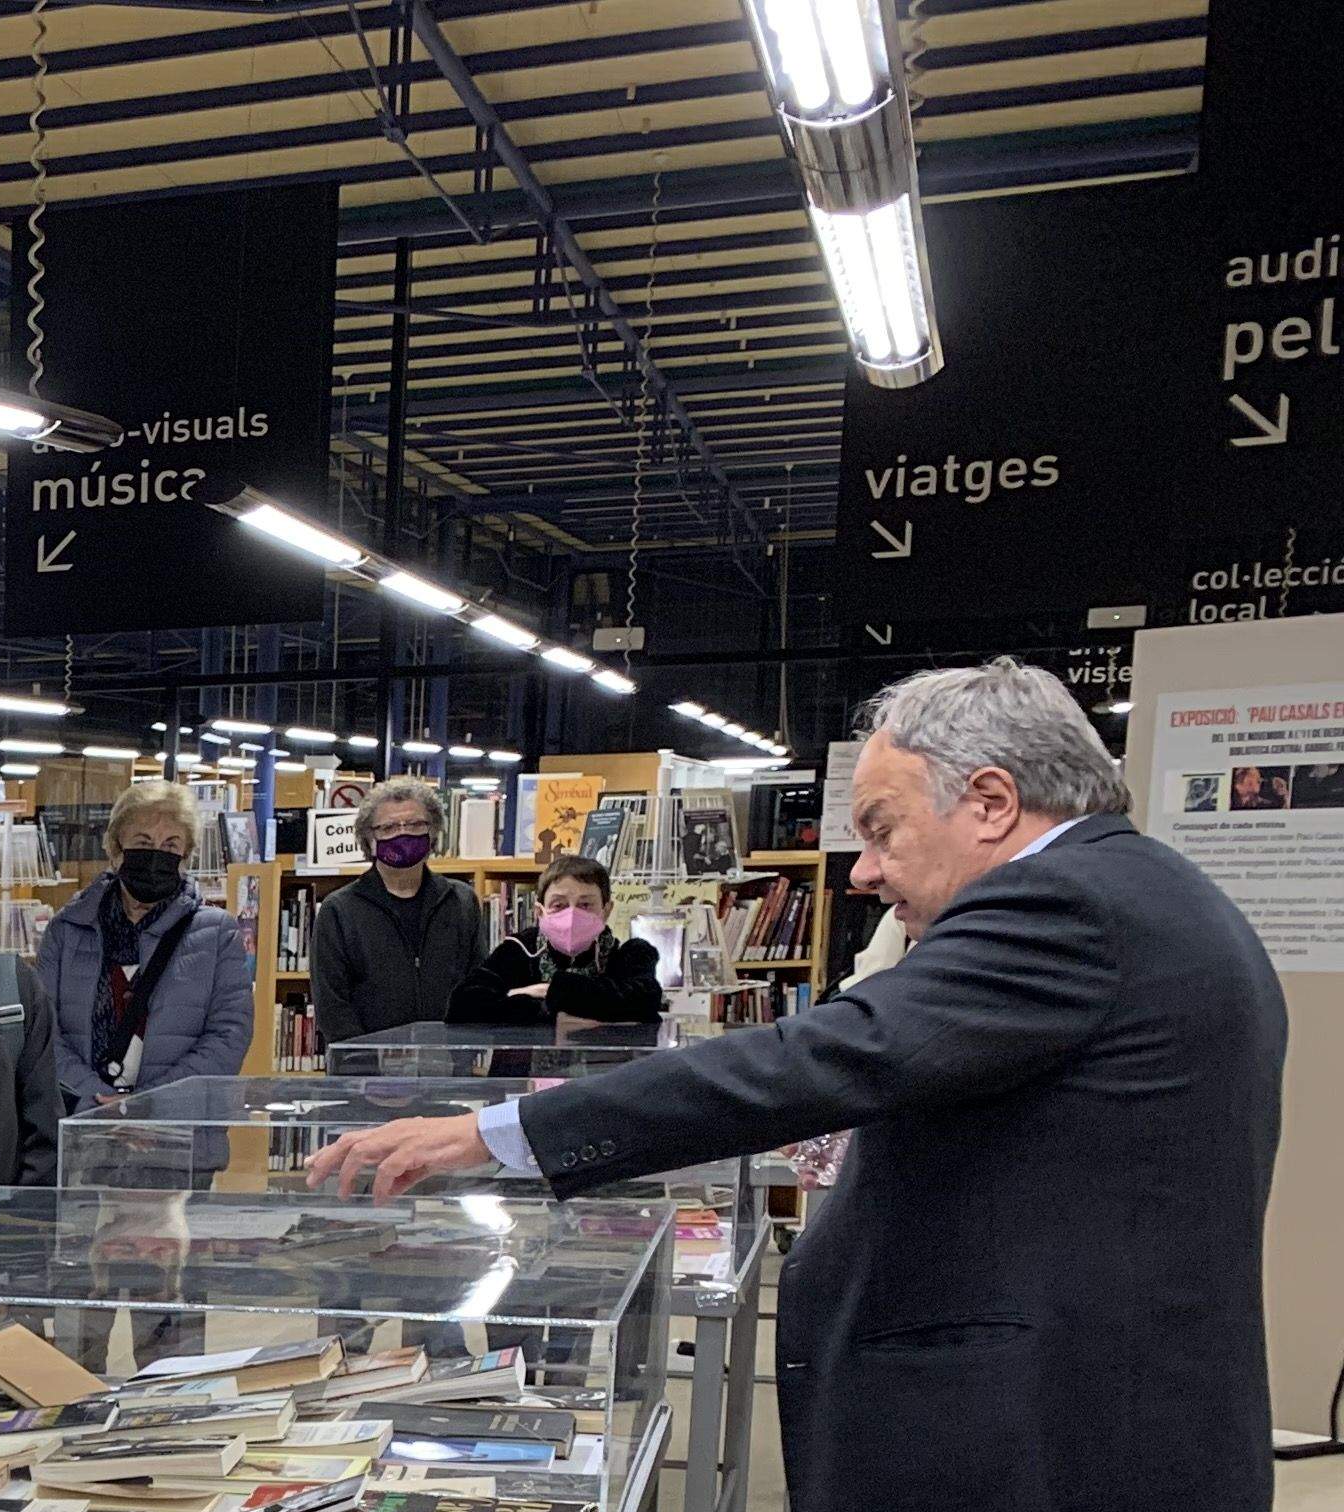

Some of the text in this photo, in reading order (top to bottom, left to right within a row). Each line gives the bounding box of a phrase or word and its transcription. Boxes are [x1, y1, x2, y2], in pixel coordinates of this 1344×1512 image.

[1225, 235, 1341, 288] audi
[1224, 298, 1340, 380] pel
[865, 454, 1060, 503] viatges
[1189, 597, 1266, 624] local
[1279, 702, 1331, 722] CASALS
